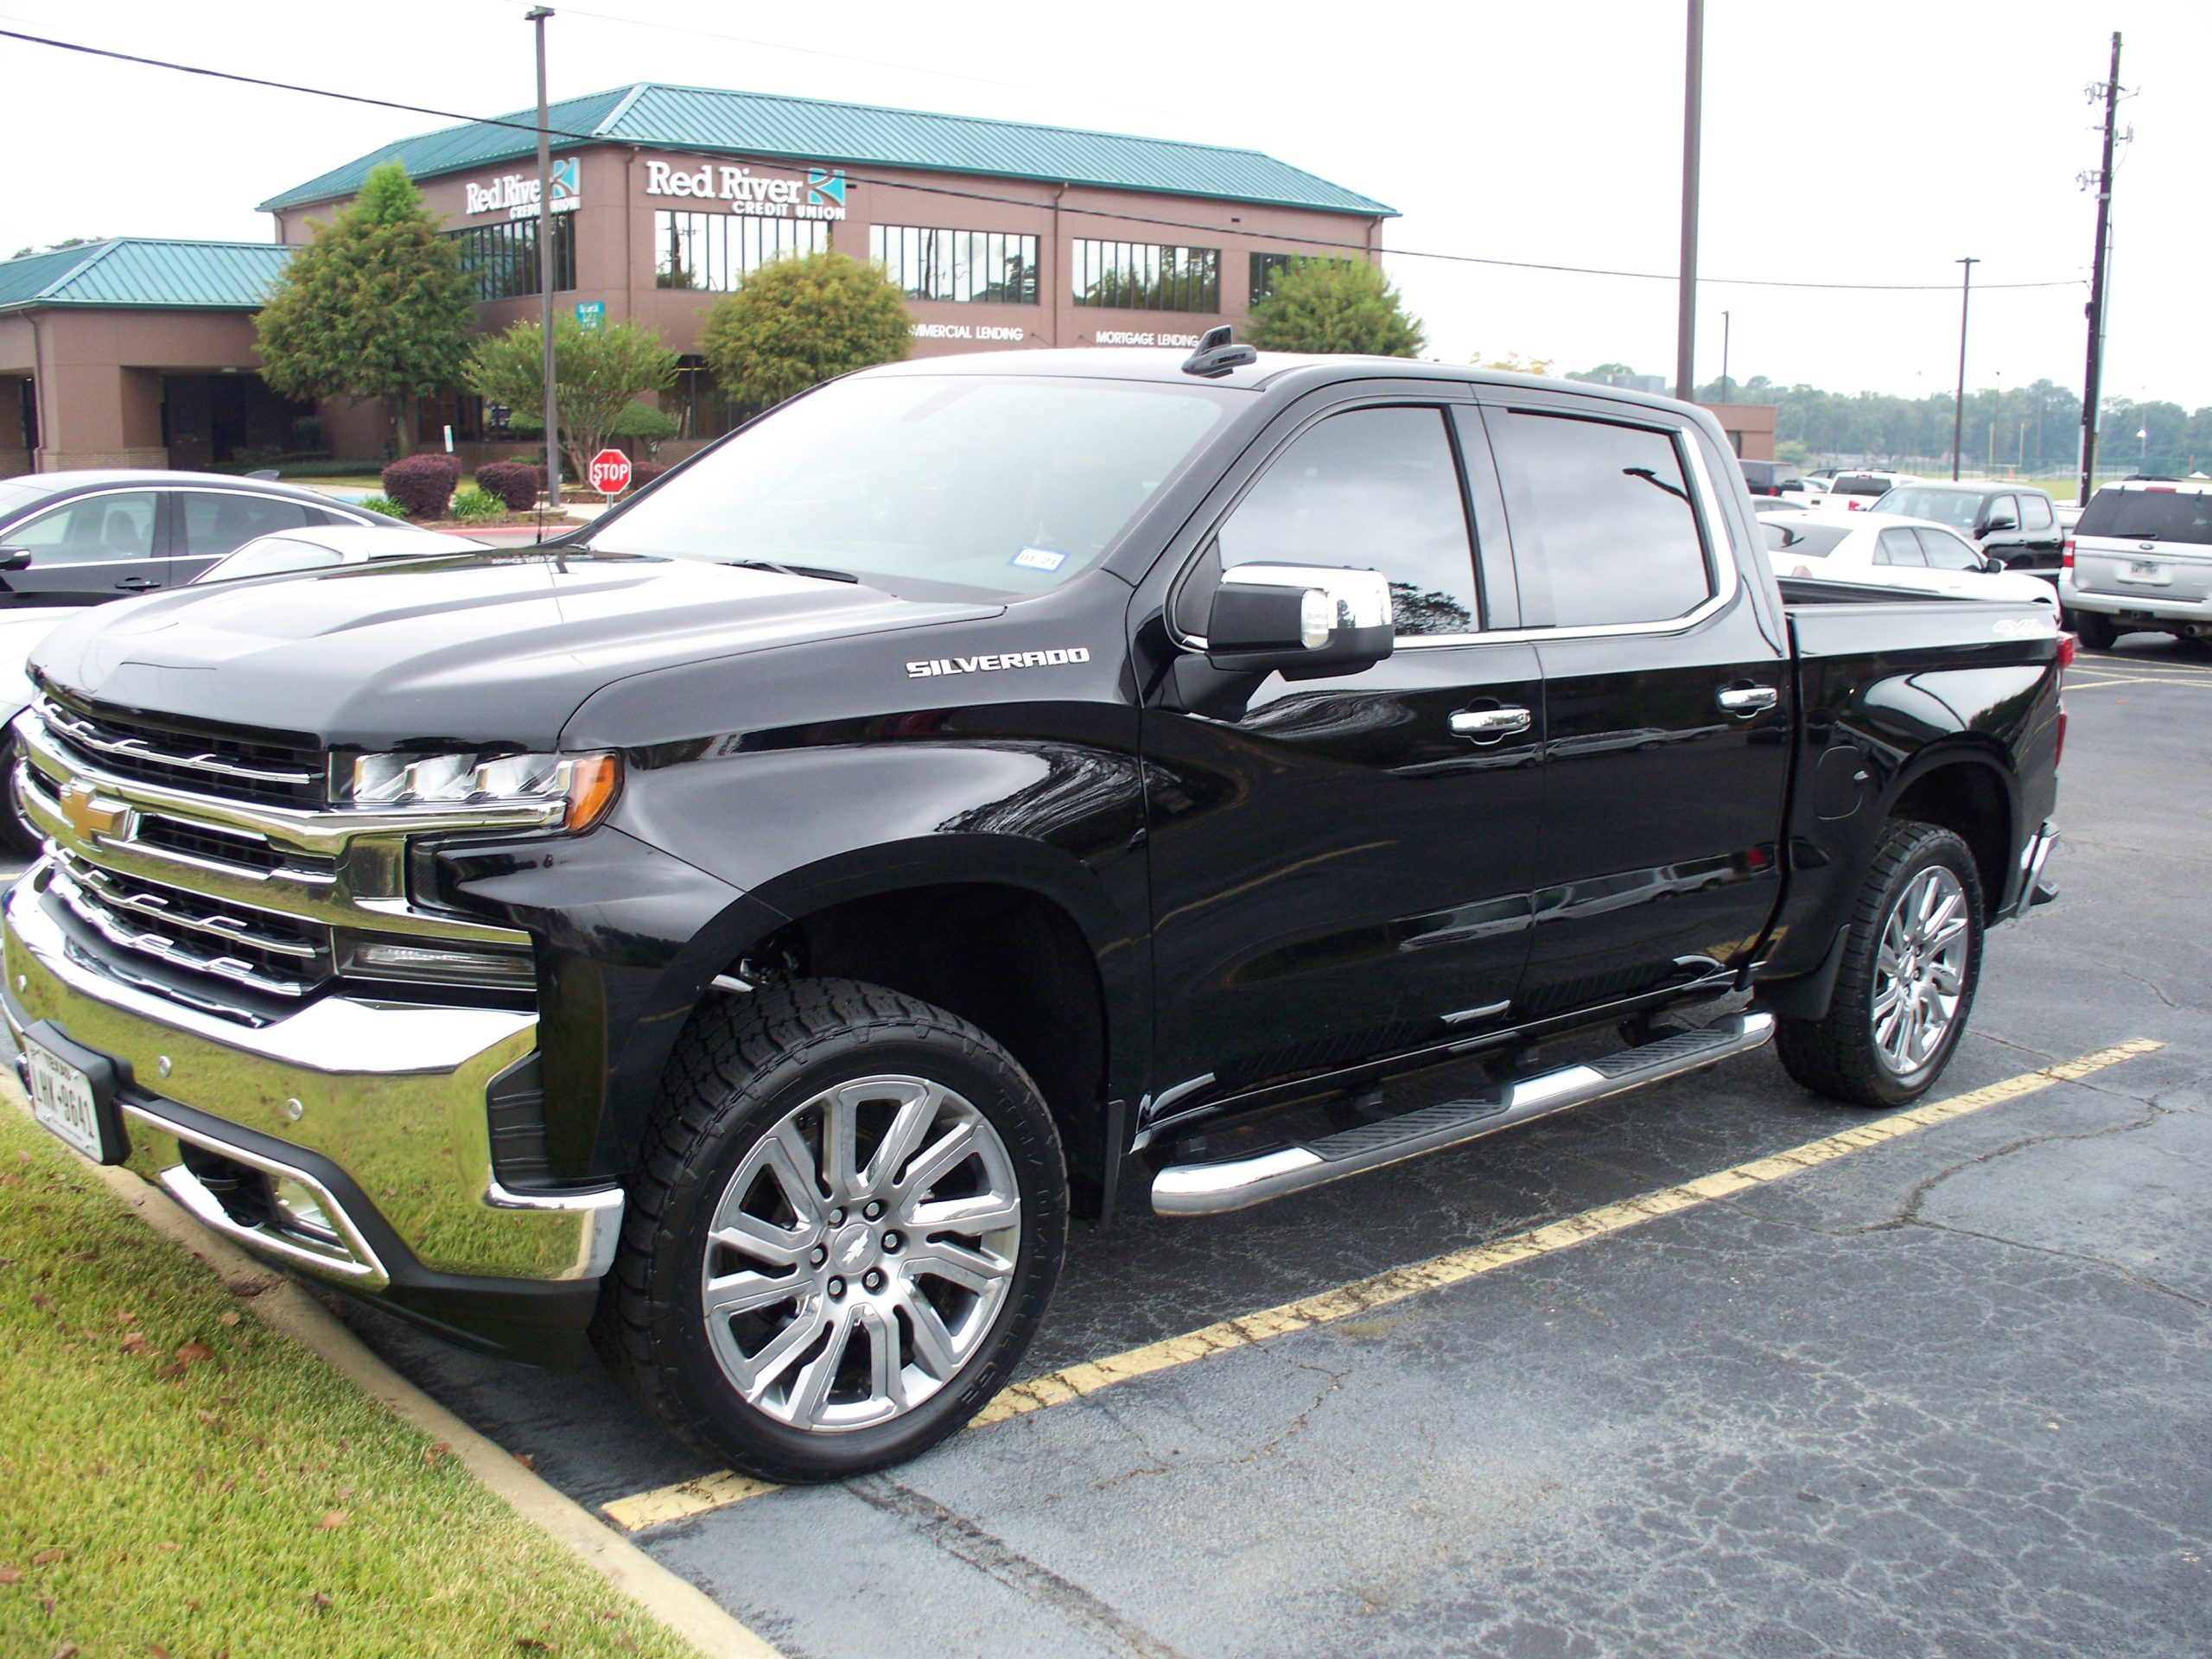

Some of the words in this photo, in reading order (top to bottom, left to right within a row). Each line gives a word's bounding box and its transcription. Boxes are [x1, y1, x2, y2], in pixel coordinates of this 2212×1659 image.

[646, 161, 715, 199] Red
[718, 167, 804, 204] River
[466, 178, 503, 214] Red
[502, 174, 541, 208] Rive
[509, 202, 541, 219] CREDI
[732, 200, 788, 217] CREDIT
[795, 205, 846, 221] UNION
[909, 323, 973, 339] MMERCIAL
[976, 326, 1024, 340] LENDING
[1096, 331, 1155, 346] MORTGAGE
[1158, 334, 1200, 347] LENDING
[593, 463, 628, 480] STOP
[906, 647, 1090, 678] SILVERADO
